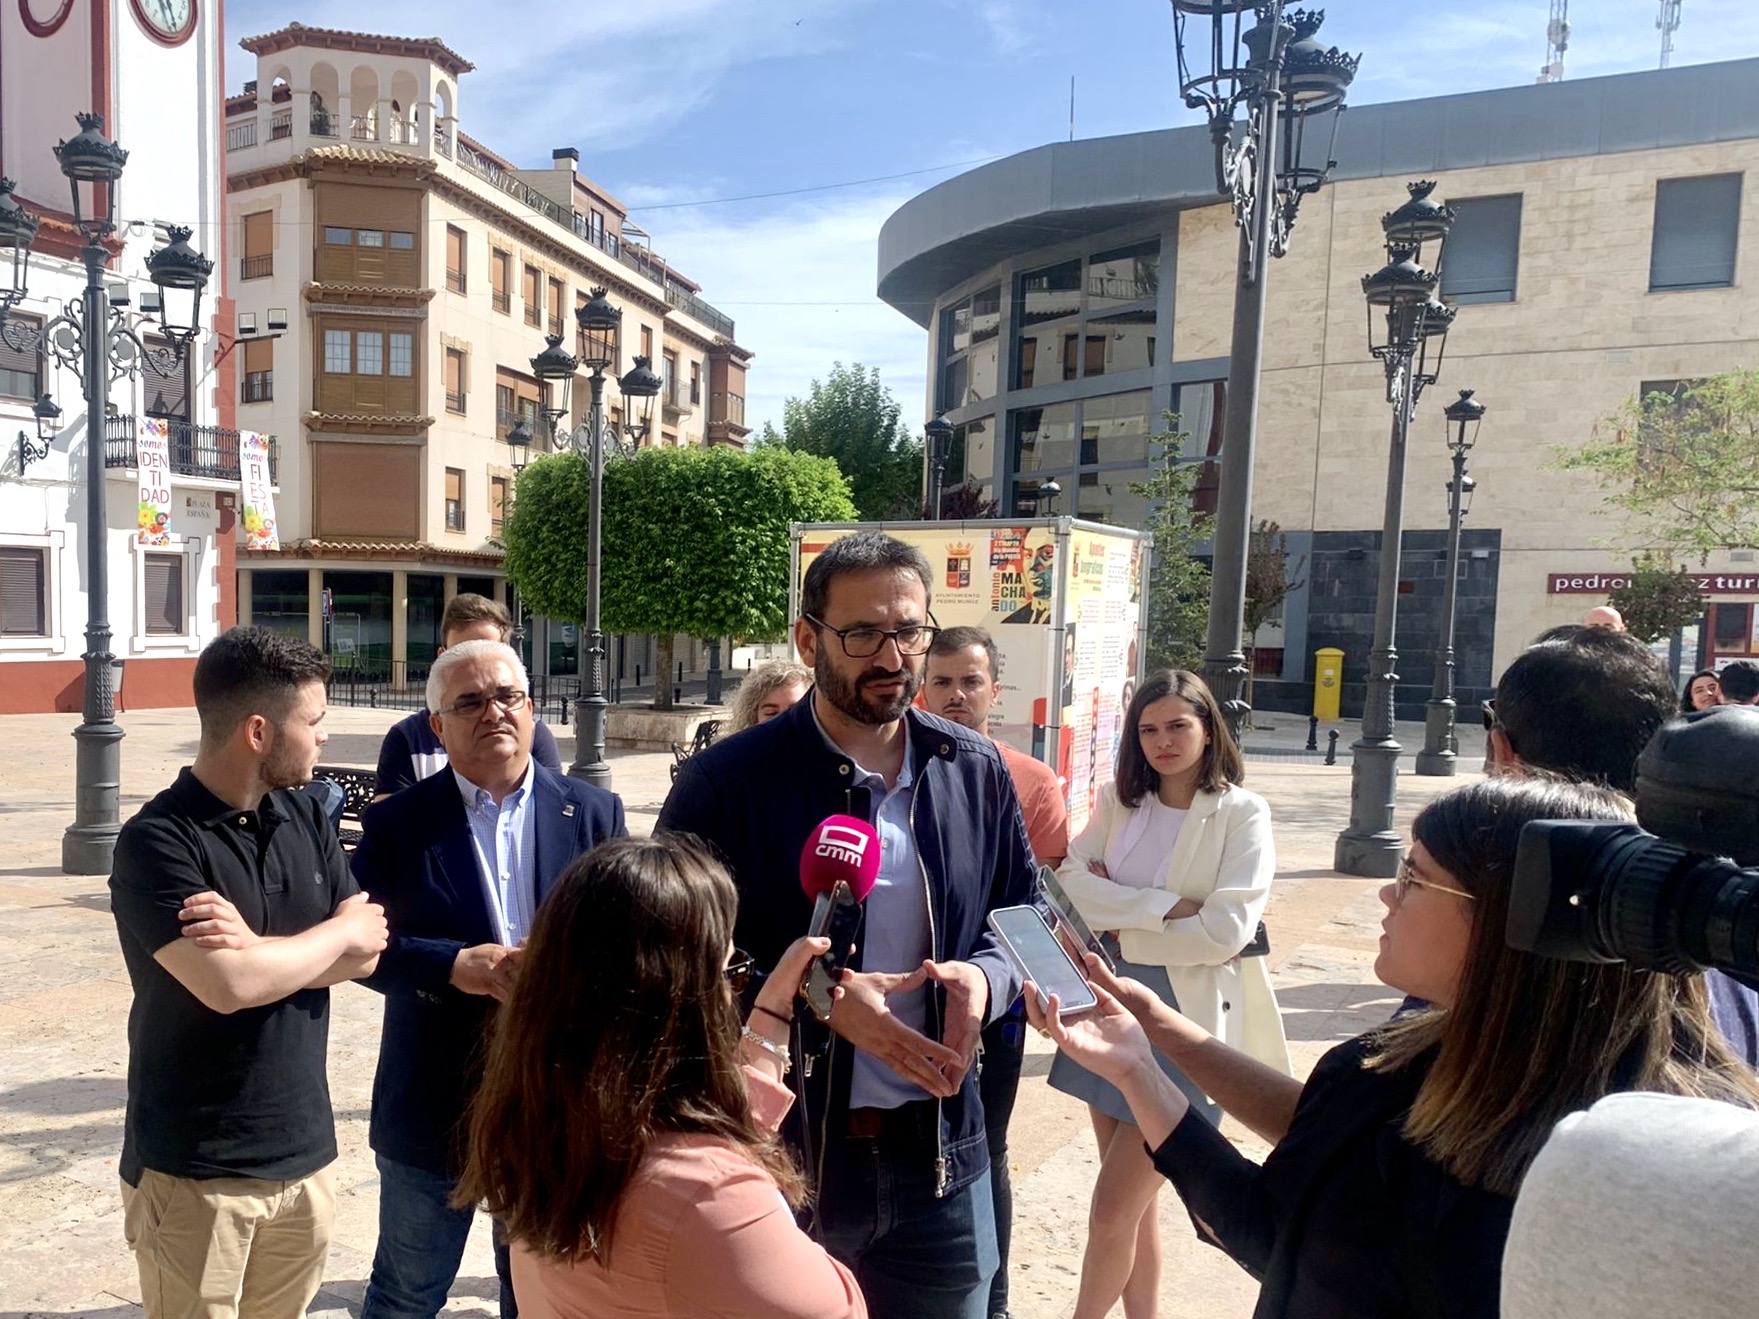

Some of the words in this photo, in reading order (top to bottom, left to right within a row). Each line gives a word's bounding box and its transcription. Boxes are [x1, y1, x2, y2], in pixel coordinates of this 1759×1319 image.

[140, 451, 169, 469] IDEN
[149, 470, 162, 487] TI
[250, 464, 262, 481] FI
[140, 488, 170, 504] DAD
[250, 482, 266, 500] ES
[186, 509, 210, 519] ESPAÑA
[1001, 572, 1022, 585] MA
[991, 572, 1001, 612] antonio
[1000, 586, 1026, 598] CHA
[1000, 600, 1017, 612] DO
[815, 844, 862, 867] cmm
